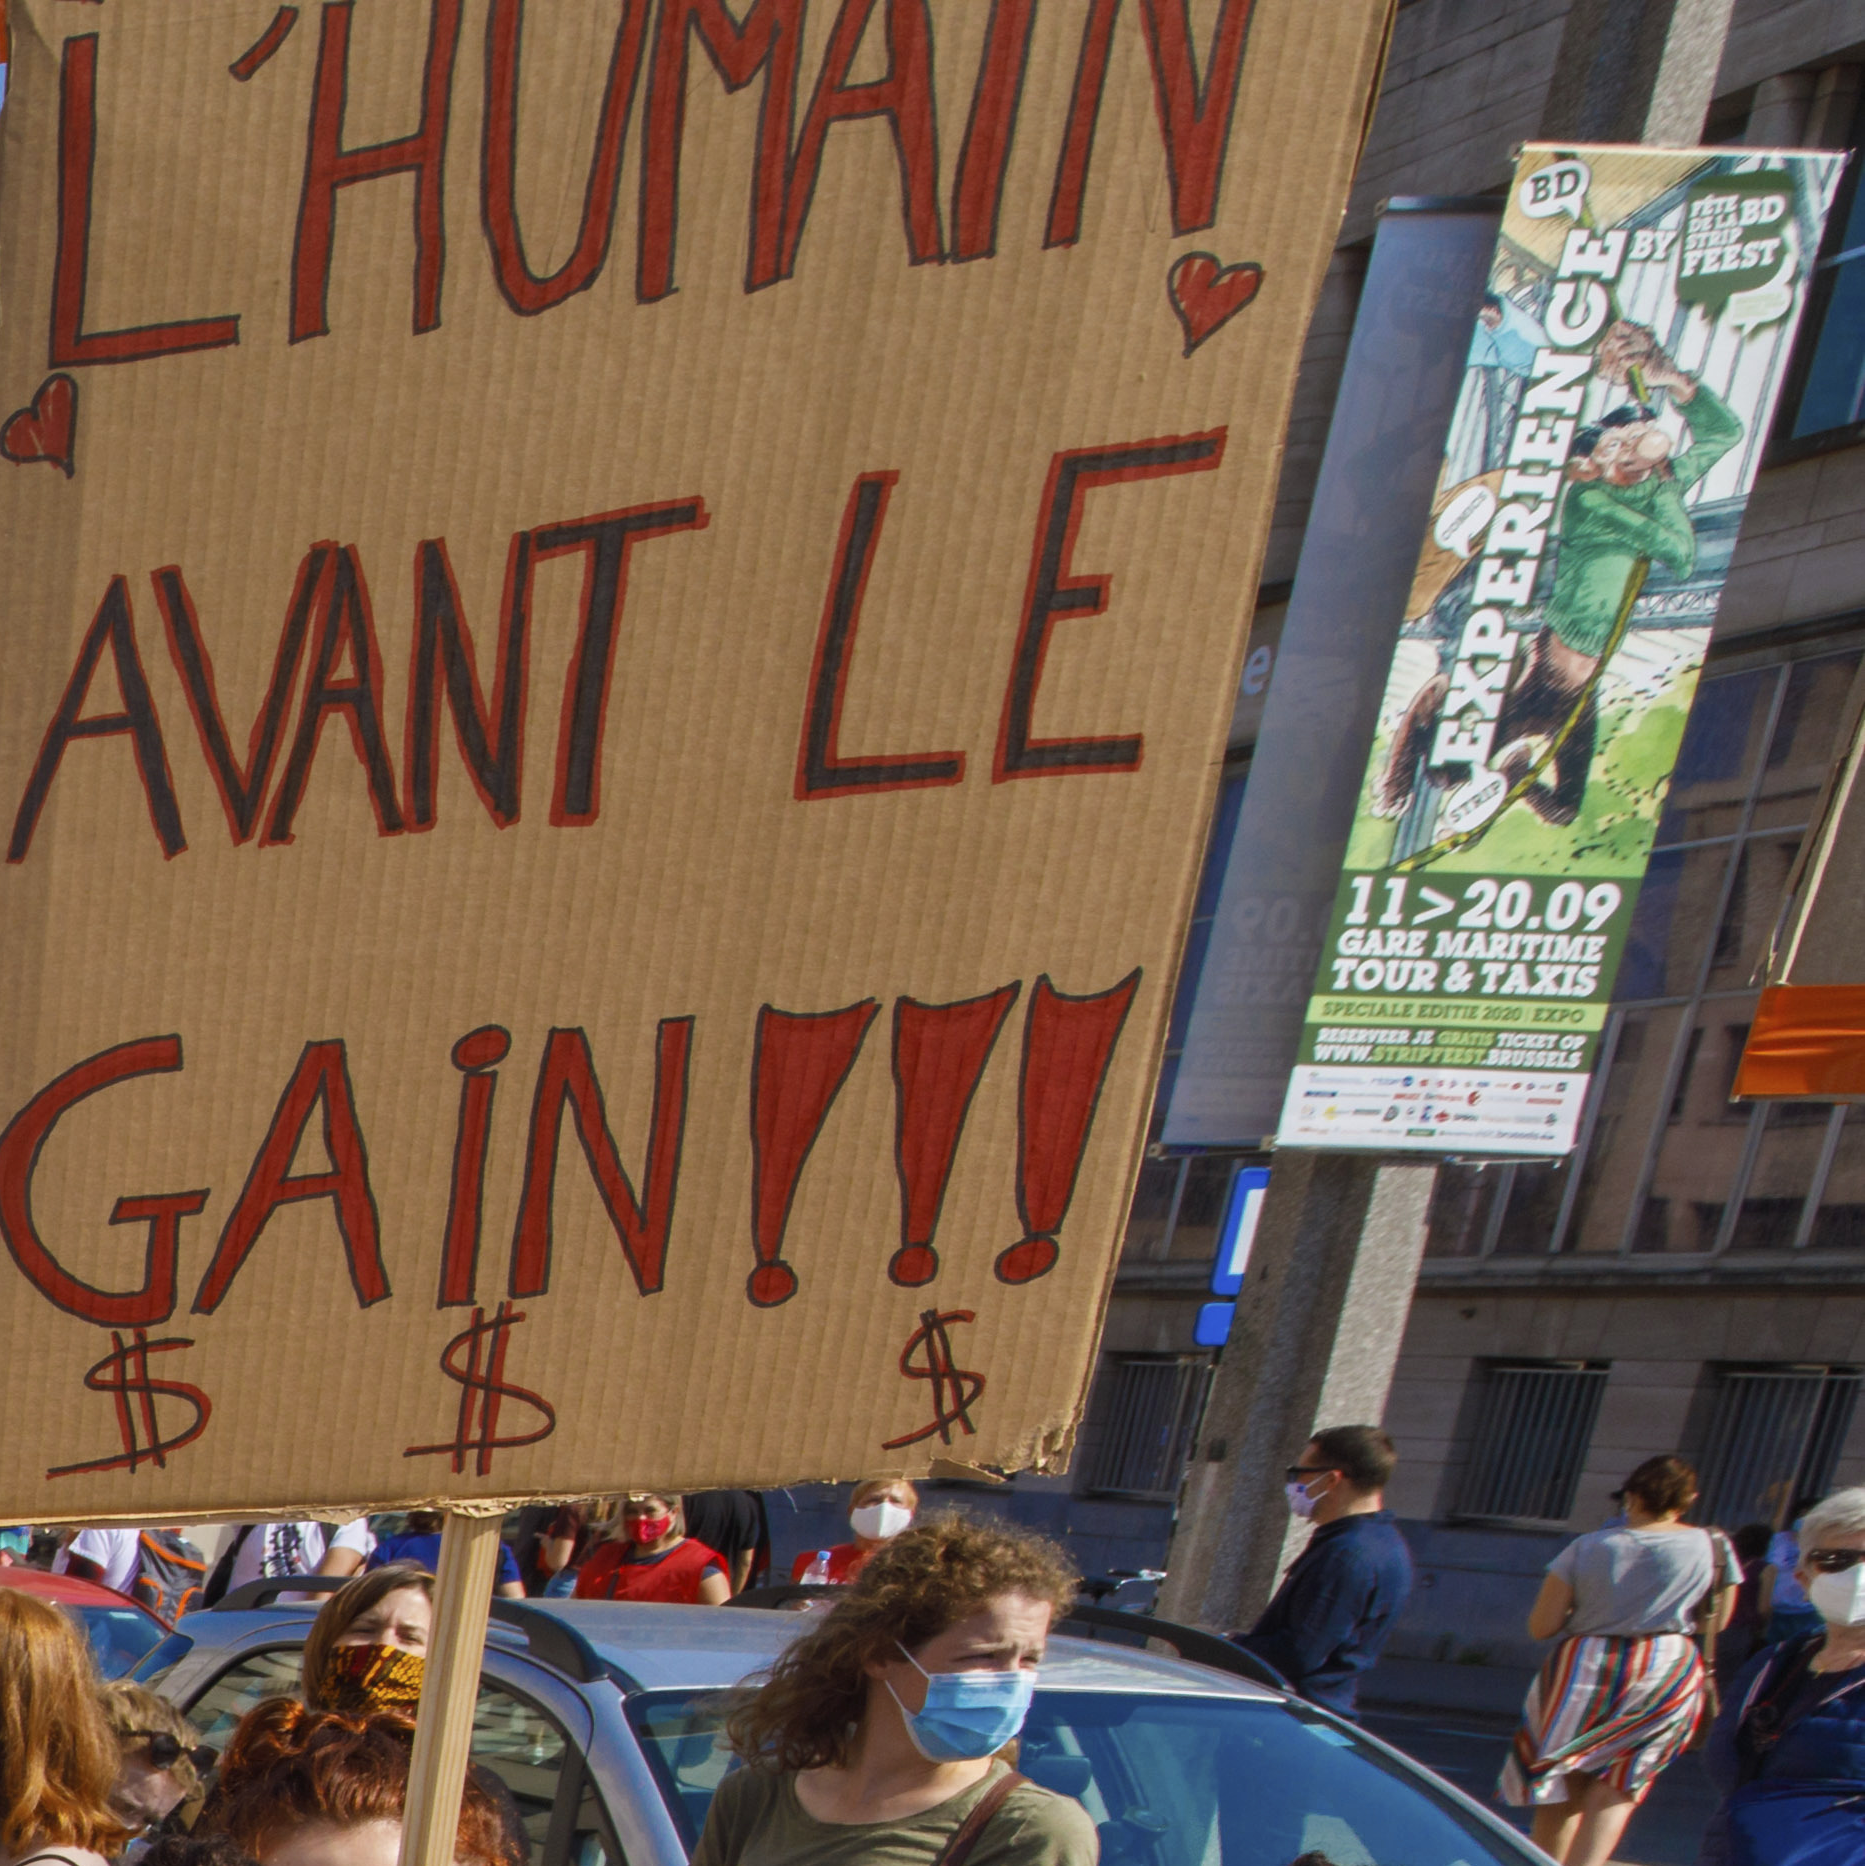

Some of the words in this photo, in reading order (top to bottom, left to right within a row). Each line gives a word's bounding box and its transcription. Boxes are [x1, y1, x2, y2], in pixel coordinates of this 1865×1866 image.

[1530, 169, 1580, 205] BD
[1739, 195, 1787, 227] BD
[1628, 229, 1678, 260] BY
[1684, 228, 1744, 251] STRIP
[1680, 237, 1782, 279] FEEST
[1428, 229, 1630, 768] EXPERIENCE
[4, 494, 709, 864] AVANT
[794, 425, 1228, 801] LE
[1448, 779, 1503, 824] STRIP
[1336, 928, 1429, 958] GARE
[1432, 931, 1608, 964] MARITIME
[1331, 957, 1440, 992] TOUR
[1443, 961, 1474, 993] &
[1480, 961, 1600, 998] TAXIS
[1322, 1000, 1413, 1018] SPECIALE
[1418, 1003, 1478, 1020] EDITIE
[1482, 1005, 1521, 1023] 2020
[1531, 1007, 1586, 1024] EXPO
[1316, 1027, 1411, 1045] RESERVEER
[1412, 1029, 1436, 1046] JE
[1437, 1030, 1497, 1047] GRATIS
[1496, 1033, 1560, 1050] TICKET
[1559, 1034, 1588, 1050] OP
